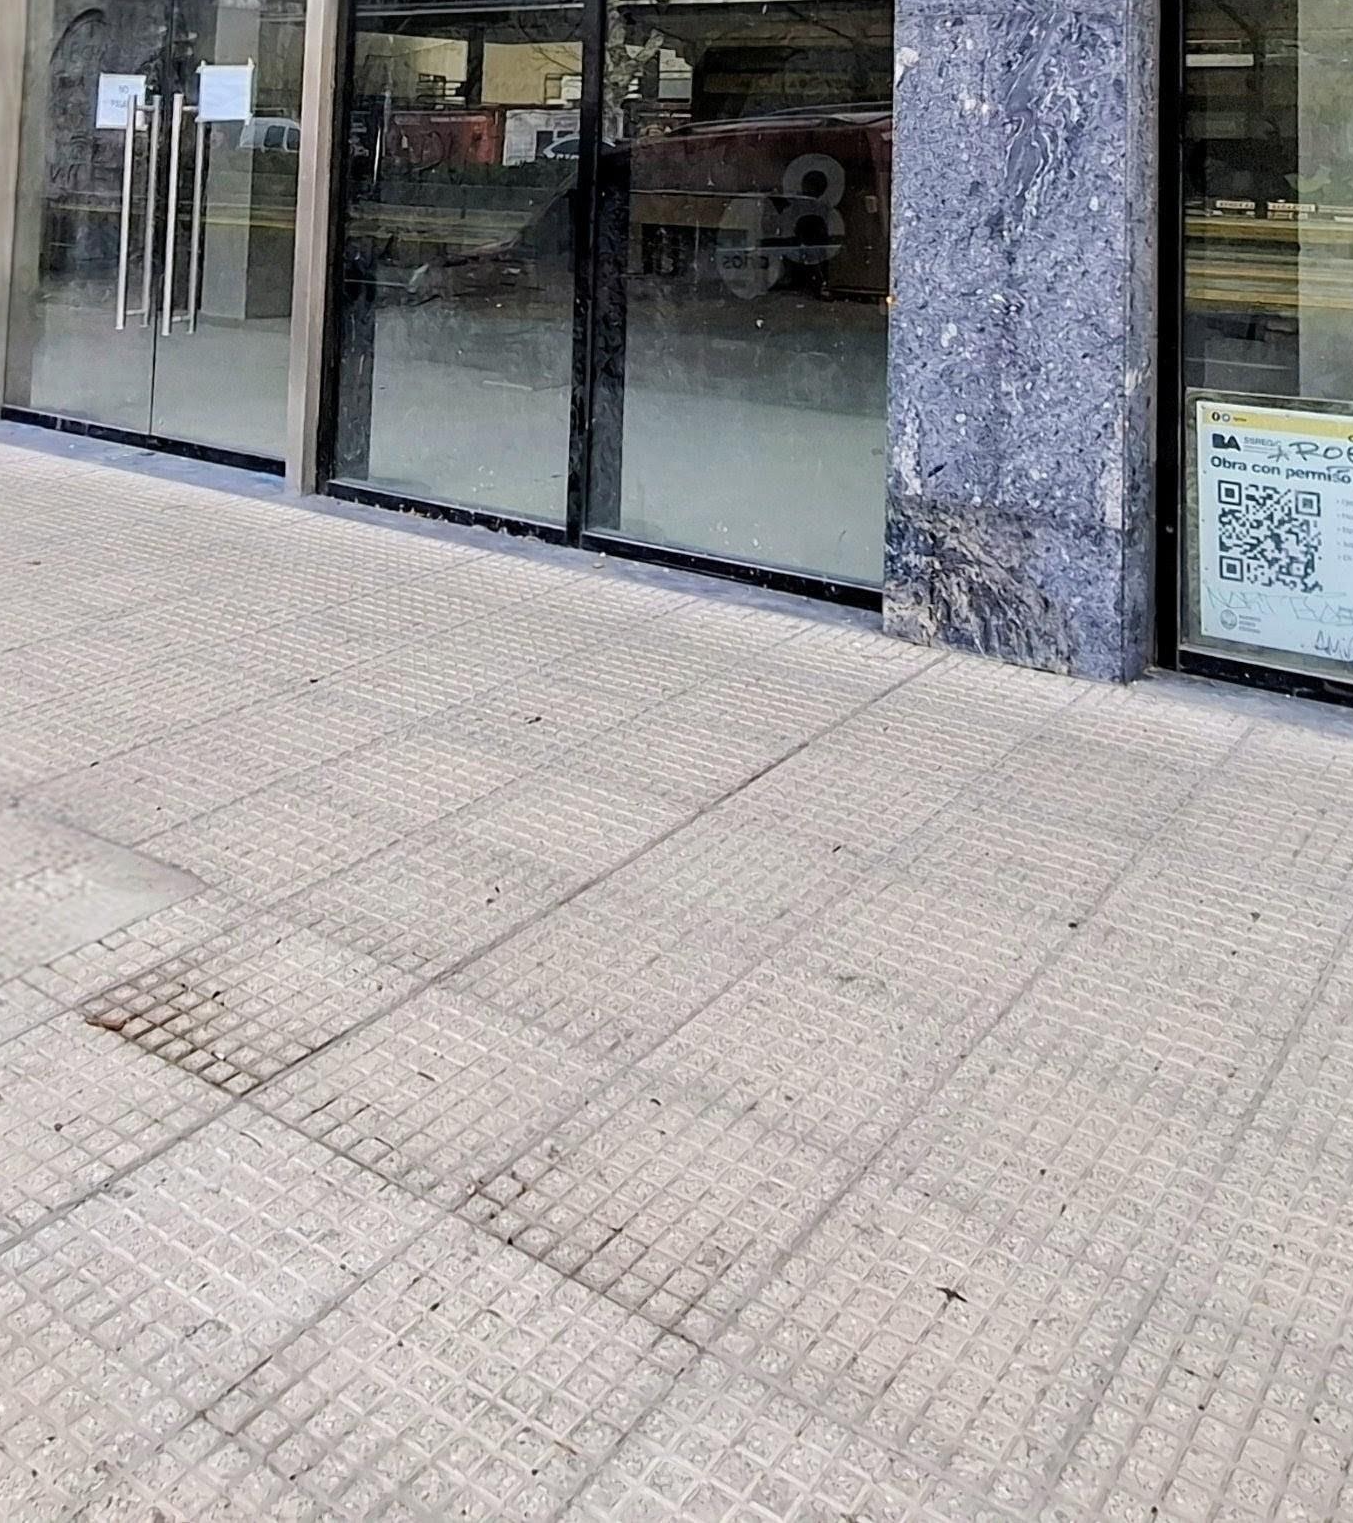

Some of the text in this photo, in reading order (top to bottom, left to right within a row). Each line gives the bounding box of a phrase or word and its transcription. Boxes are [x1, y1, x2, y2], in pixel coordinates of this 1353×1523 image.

[1212, 433, 1241, 452] BA
[1210, 455, 1248, 471] Obra
[1252, 462, 1281, 476] con
[1286, 466, 1352, 485] permiso
